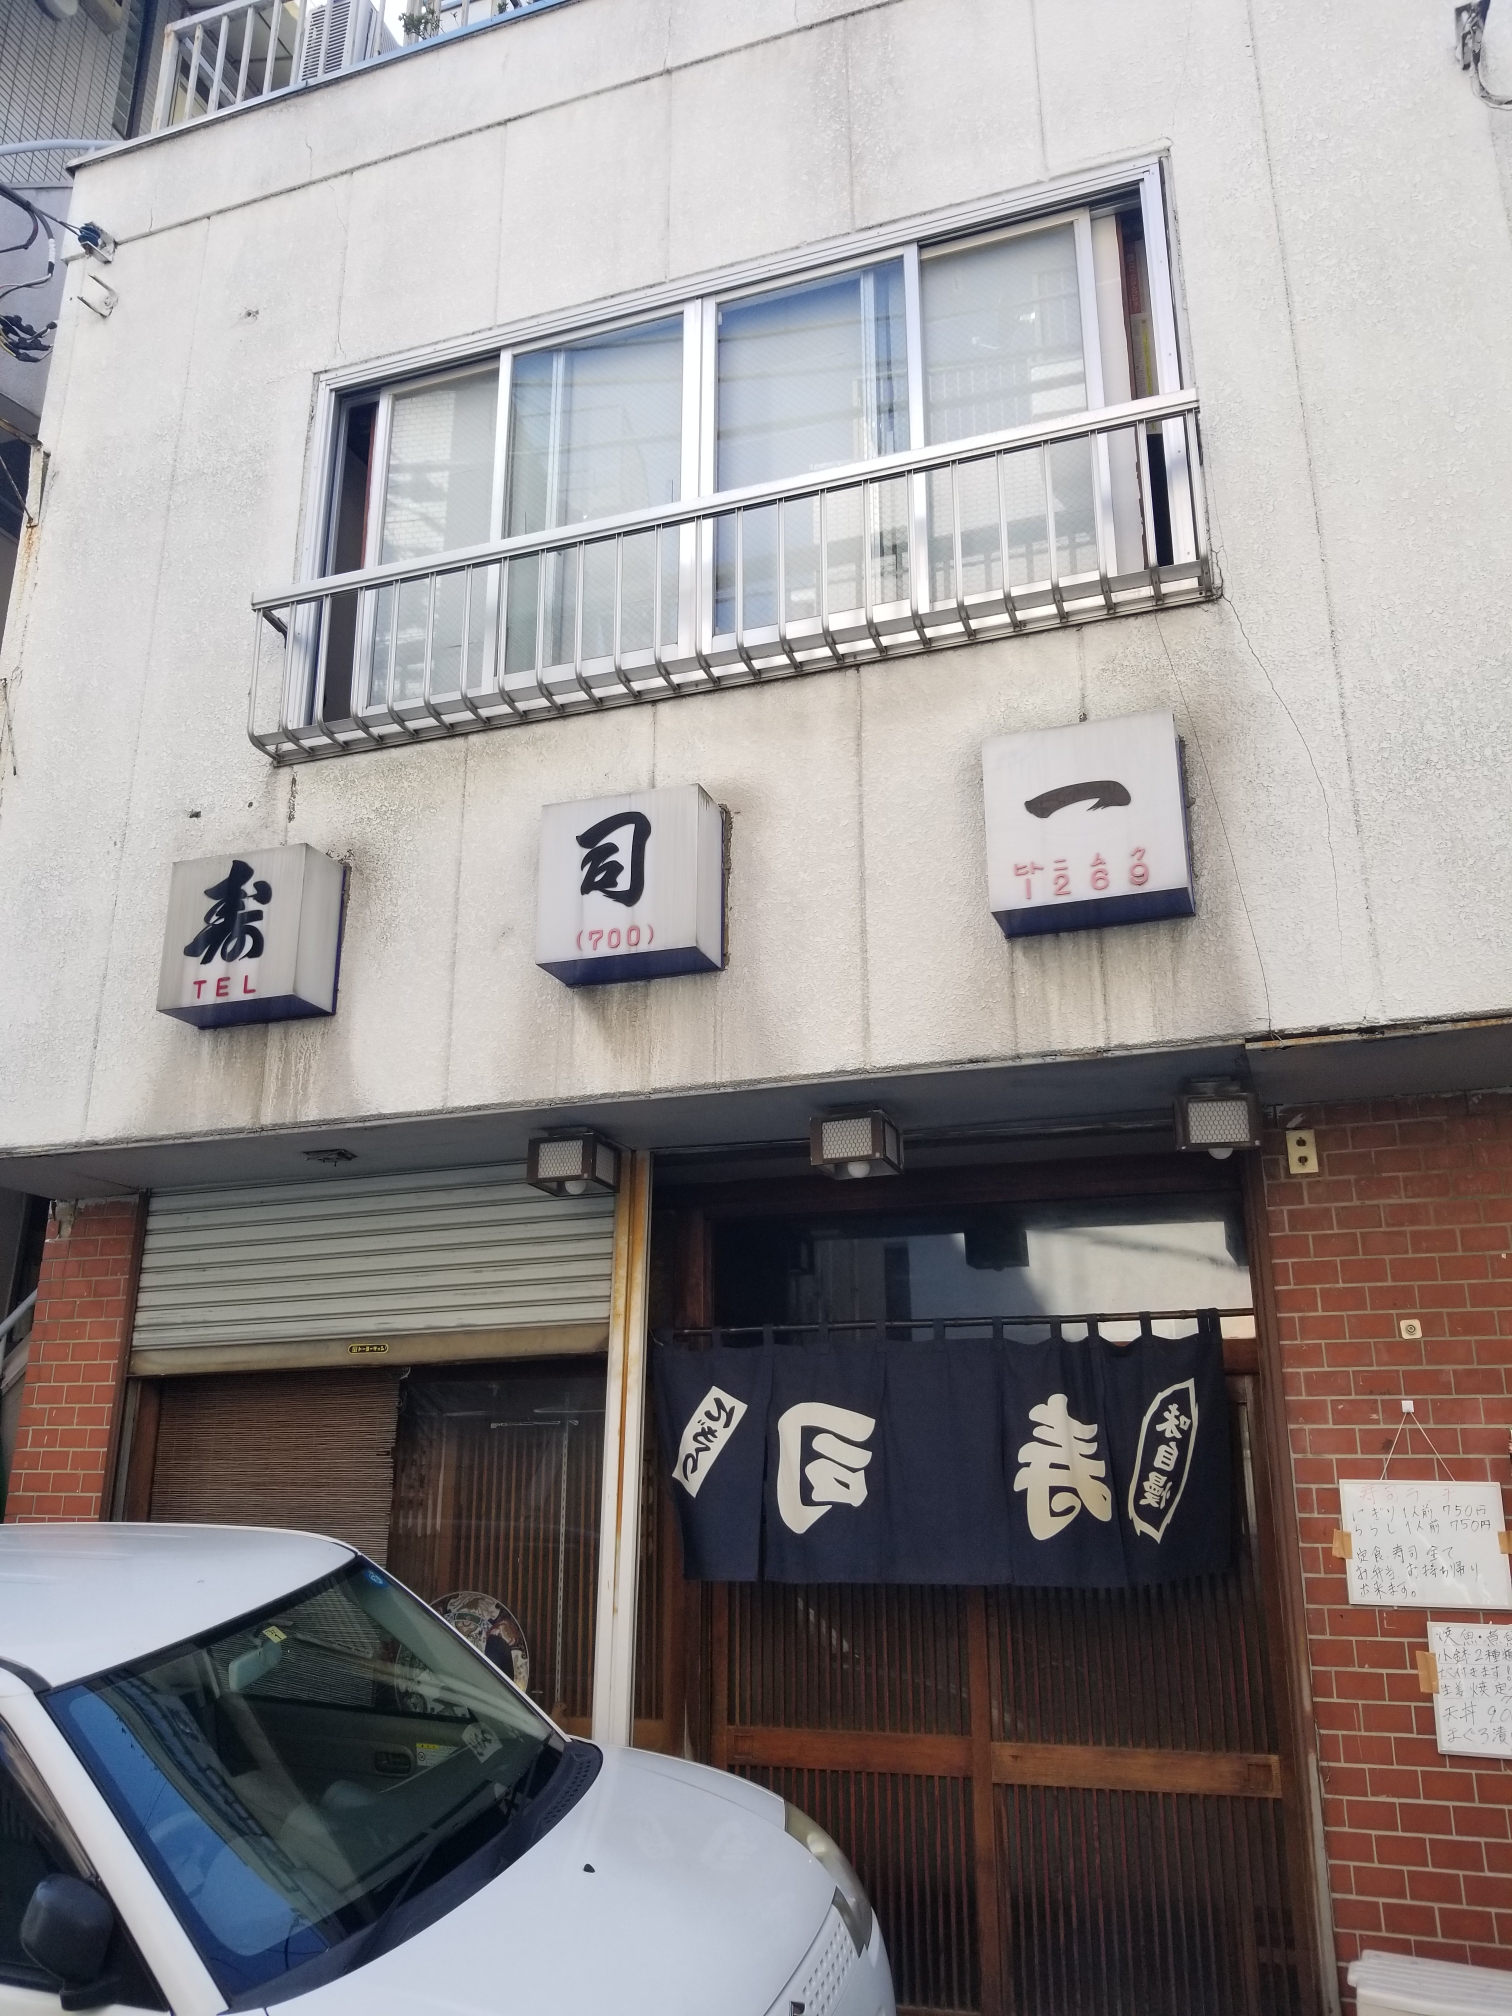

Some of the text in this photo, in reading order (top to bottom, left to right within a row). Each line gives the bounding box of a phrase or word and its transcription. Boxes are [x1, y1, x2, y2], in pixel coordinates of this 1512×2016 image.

[1024, 780, 1132, 819] 一
[575, 811, 652, 907] 司
[183, 859, 273, 965] 寿
[576, 924, 654, 952] (700)
[193, 974, 256, 1000] TEL
[1442, 1504, 1486, 1517] 750円
[1450, 1518, 1491, 1532] 750円
[1440, 1680, 1512, 1698] 生姜焼定
[1442, 1700, 1477, 1726] 天丼
[1447, 1725, 1512, 1745] まぐろ漬
